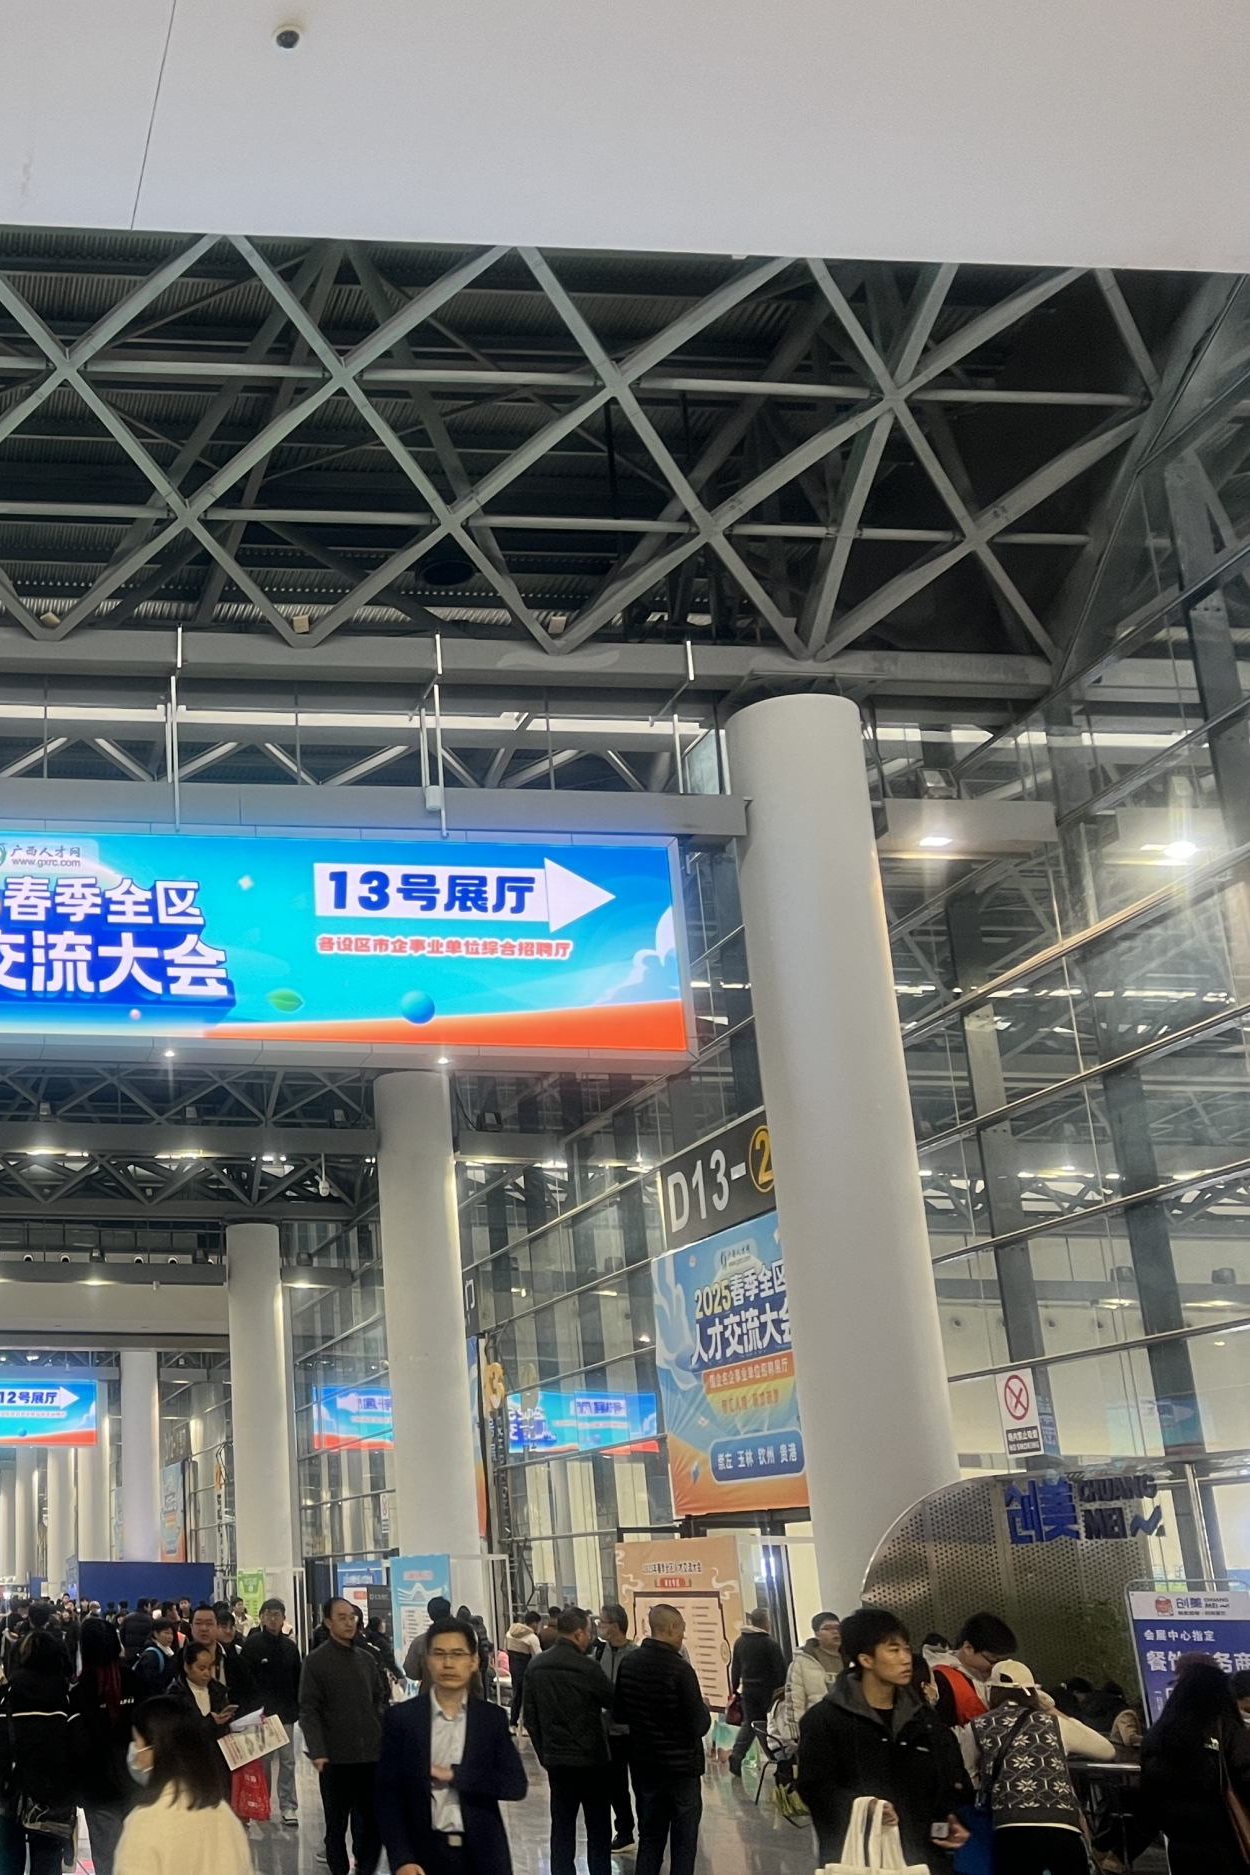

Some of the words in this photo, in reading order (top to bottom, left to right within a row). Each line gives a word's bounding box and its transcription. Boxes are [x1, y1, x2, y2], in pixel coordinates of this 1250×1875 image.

[10, 844, 82, 859] 广西人才网
[327, 870, 537, 916] 13号展厅
[317, 935, 572, 958] 各设区市企事业单位综合招聘厅
[0, 1390, 58, 1405] 12号展厅
[1078, 1473, 1158, 1503] CHUANG
[1082, 1506, 1128, 1540] MEI
[1143, 1629, 1215, 1642] 会展中心指定
